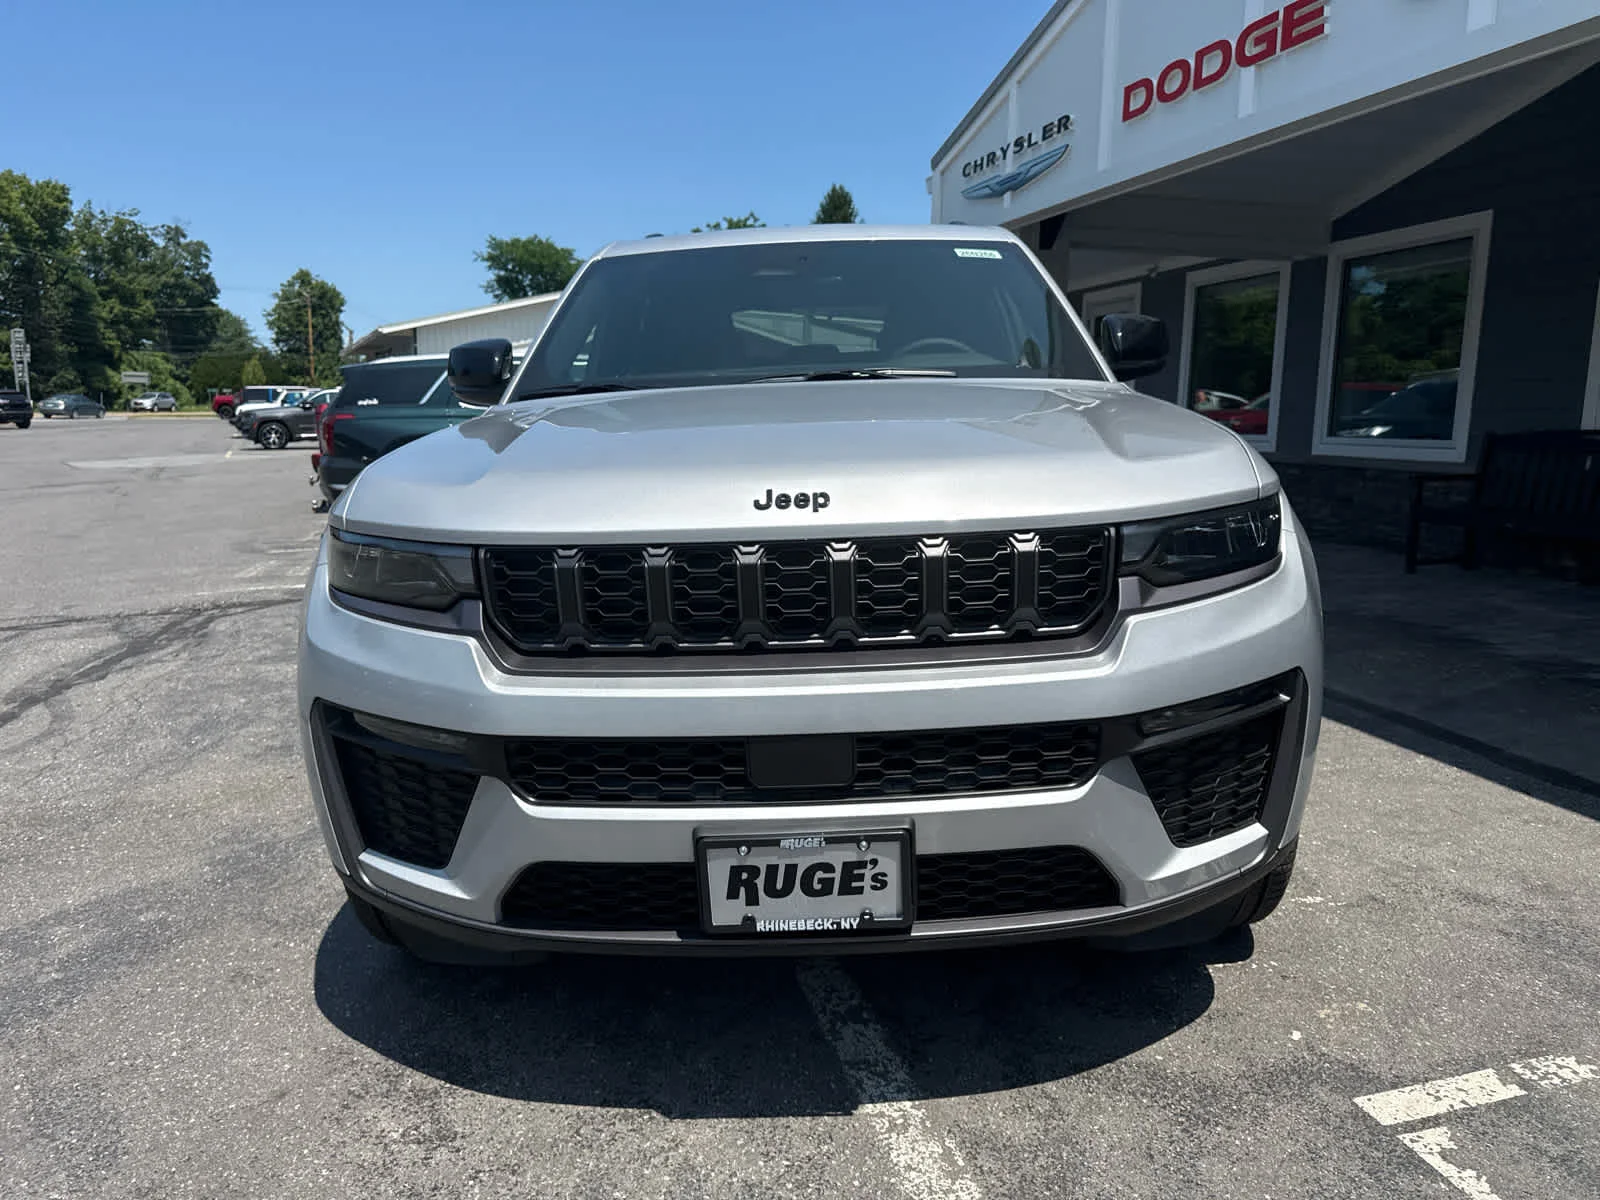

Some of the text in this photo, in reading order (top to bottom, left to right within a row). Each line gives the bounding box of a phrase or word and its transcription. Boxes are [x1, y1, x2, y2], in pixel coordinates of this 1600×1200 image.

[1122, 0, 1326, 123] DODGE
[962, 114, 1073, 178] CHRYSLER
[753, 488, 831, 512] Jeep
[726, 858, 889, 907] RUGE's
[840, 917, 860, 930] NY
